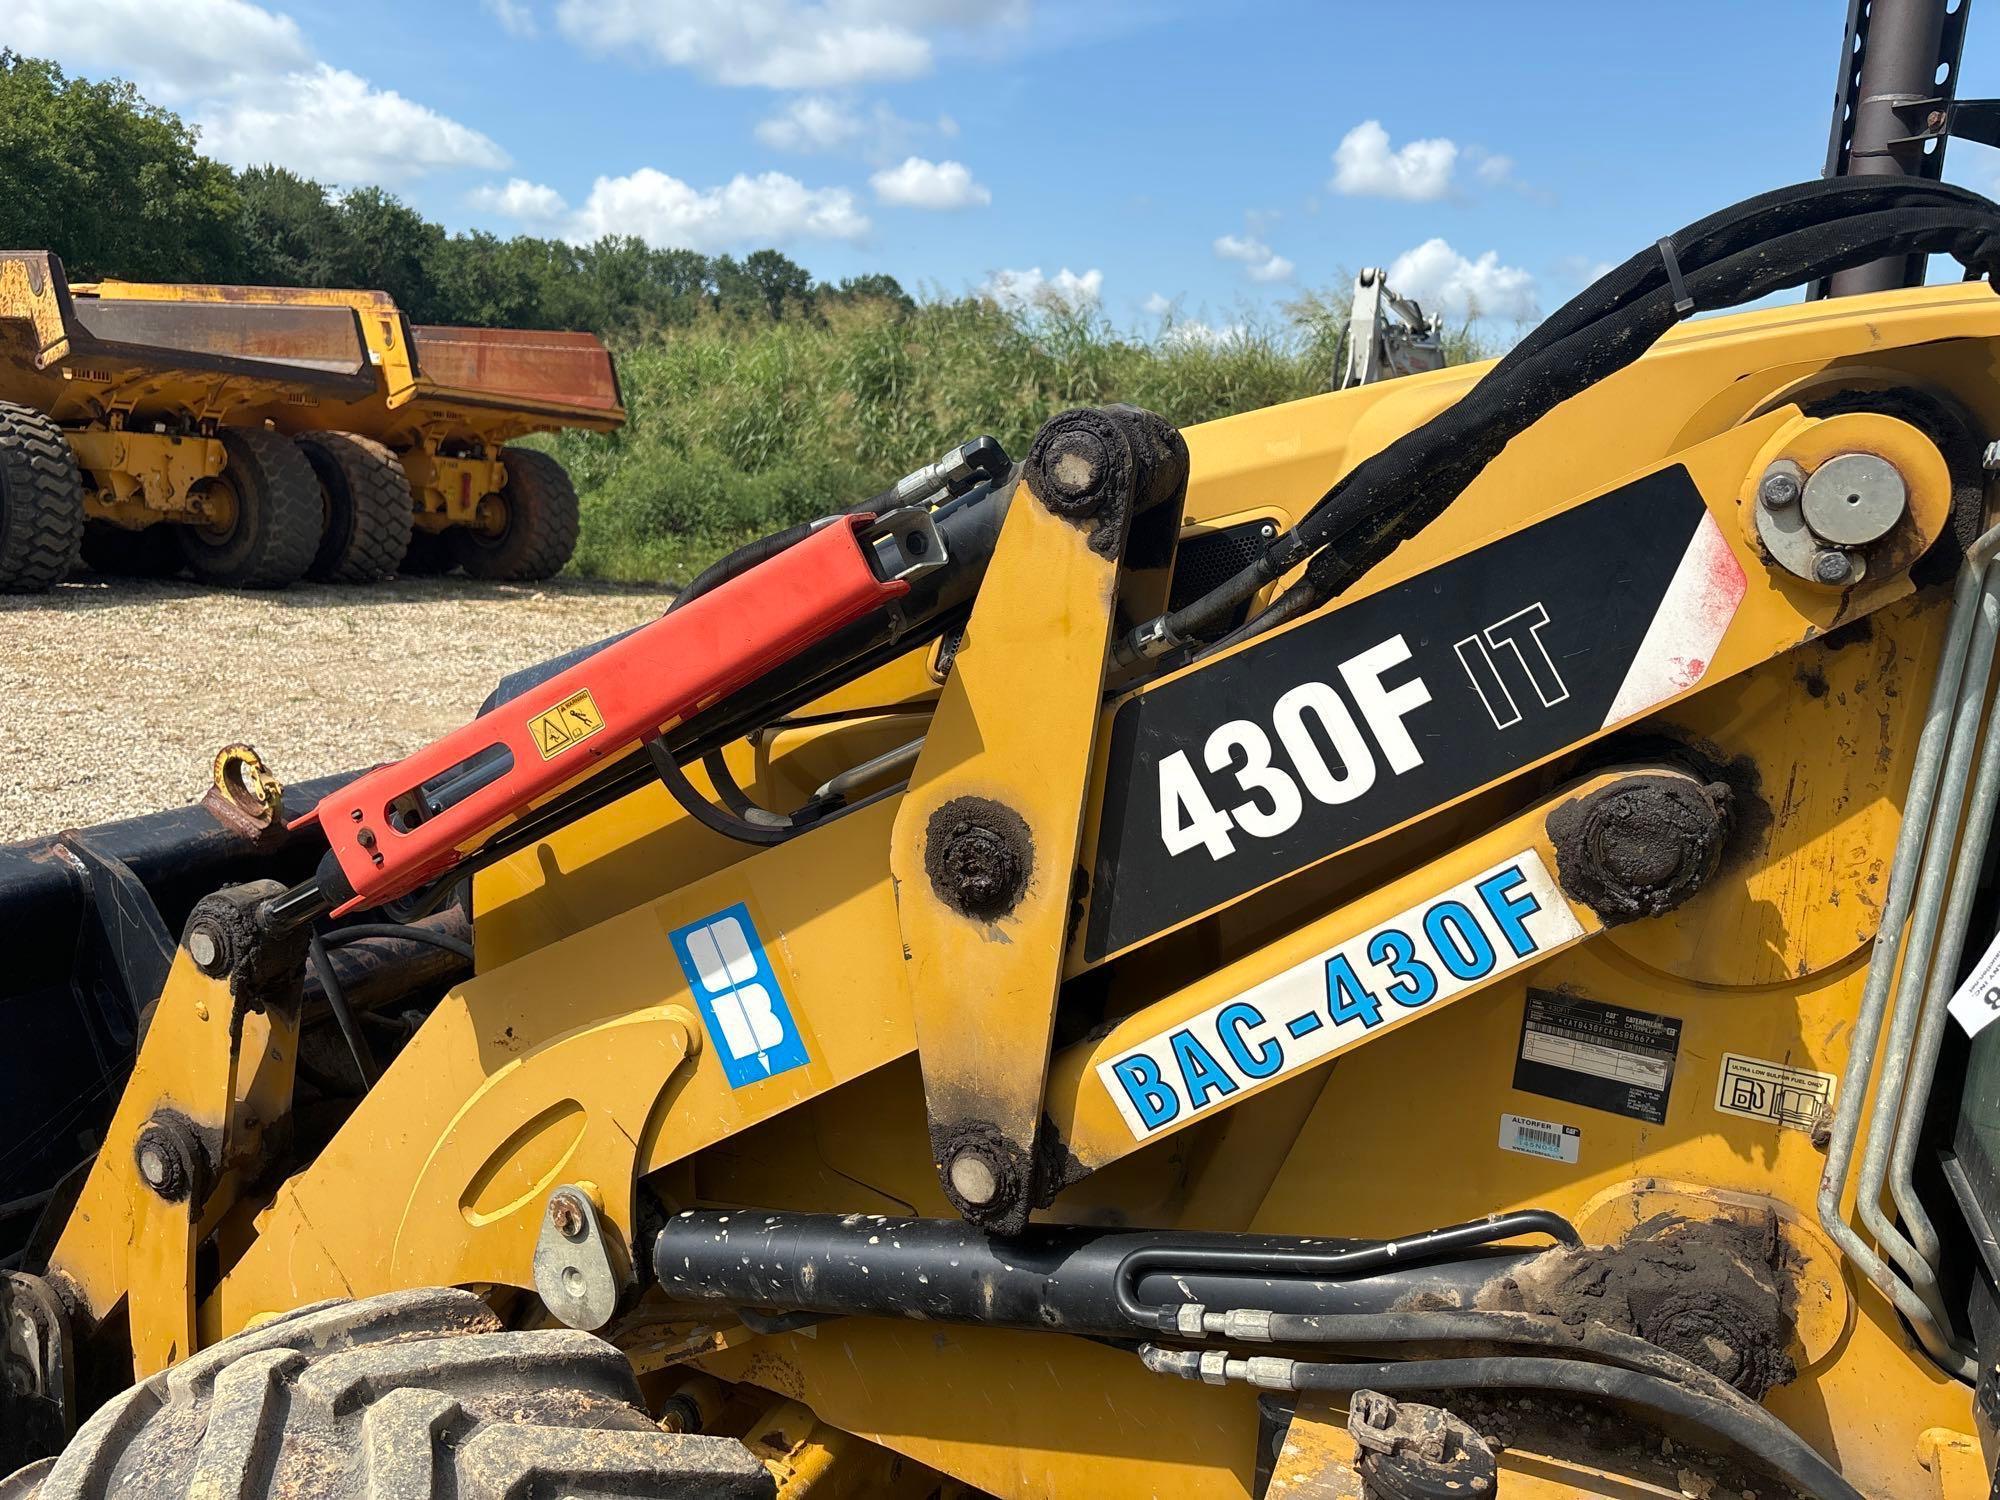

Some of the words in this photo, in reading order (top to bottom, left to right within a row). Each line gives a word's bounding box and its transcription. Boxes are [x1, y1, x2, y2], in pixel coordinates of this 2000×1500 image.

[1158, 633, 1432, 861] 430F
[1453, 602, 1569, 729] IT
[1112, 865, 1541, 1131] BAC-430F
[1512, 1117, 1552, 1130] ALTORFER
[1731, 1064, 1751, 1073] ULTRA
[1751, 1068, 1766, 1077] LOW
[1790, 1076, 1806, 1085] FUEL
[1807, 1080, 1824, 1088] ONLY
